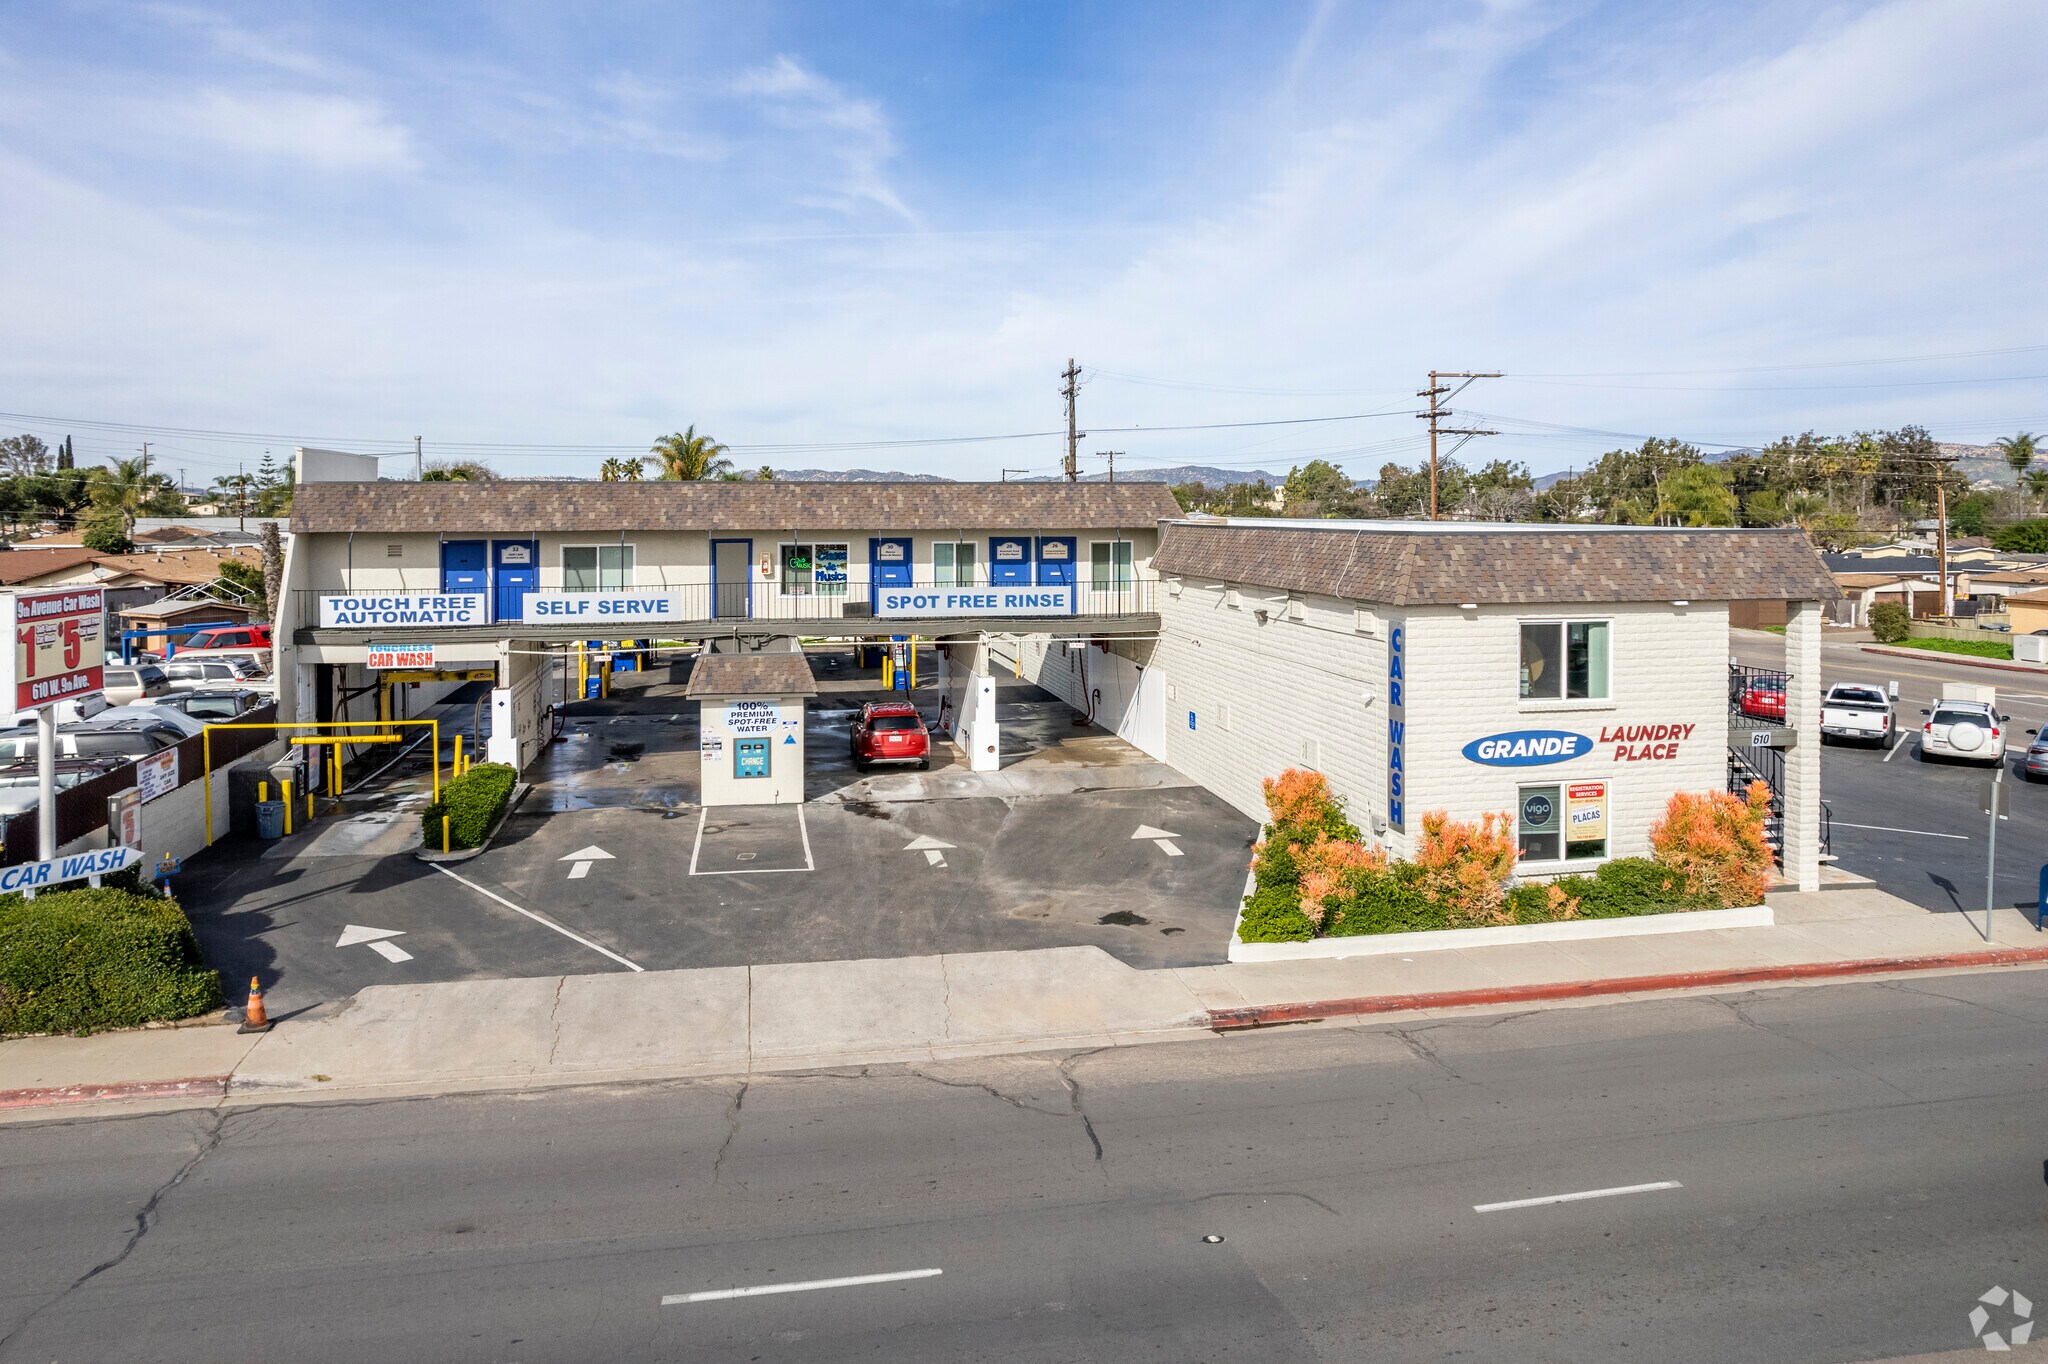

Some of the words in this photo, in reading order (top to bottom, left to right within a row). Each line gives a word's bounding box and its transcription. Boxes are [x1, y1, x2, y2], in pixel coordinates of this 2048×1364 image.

[31, 600, 62, 616] Avenue
[63, 596, 78, 613] Car
[78, 594, 100, 610] Wash
[329, 598, 410, 611] TOUCH
[419, 596, 476, 610] FREE
[536, 600, 590, 615] SELF
[598, 600, 669, 614] SERVE
[886, 595, 940, 609] SPOT
[947, 594, 998, 608] FREE
[1004, 594, 1064, 608] RINSE
[335, 610, 470, 624] AUTOMATIC
[369, 644, 433, 652] TOUCHLESS
[369, 653, 394, 667] CAR
[396, 652, 433, 666] WASH
[32, 680, 48, 700] 610
[73, 674, 90, 690] Ave.
[736, 702, 768, 710] 100%
[1598, 724, 1696, 744] LAUNDRY
[1753, 734, 1770, 744] 610
[1478, 736, 1578, 760] GRANDE
[1613, 742, 1679, 762] PLACE
[741, 757, 764, 766] CHANGE
[1526, 803, 1550, 814] vigo
[1572, 810, 1600, 823] PLACAS
[1, 863, 52, 890] CAR
[62, 848, 126, 878] WASH
